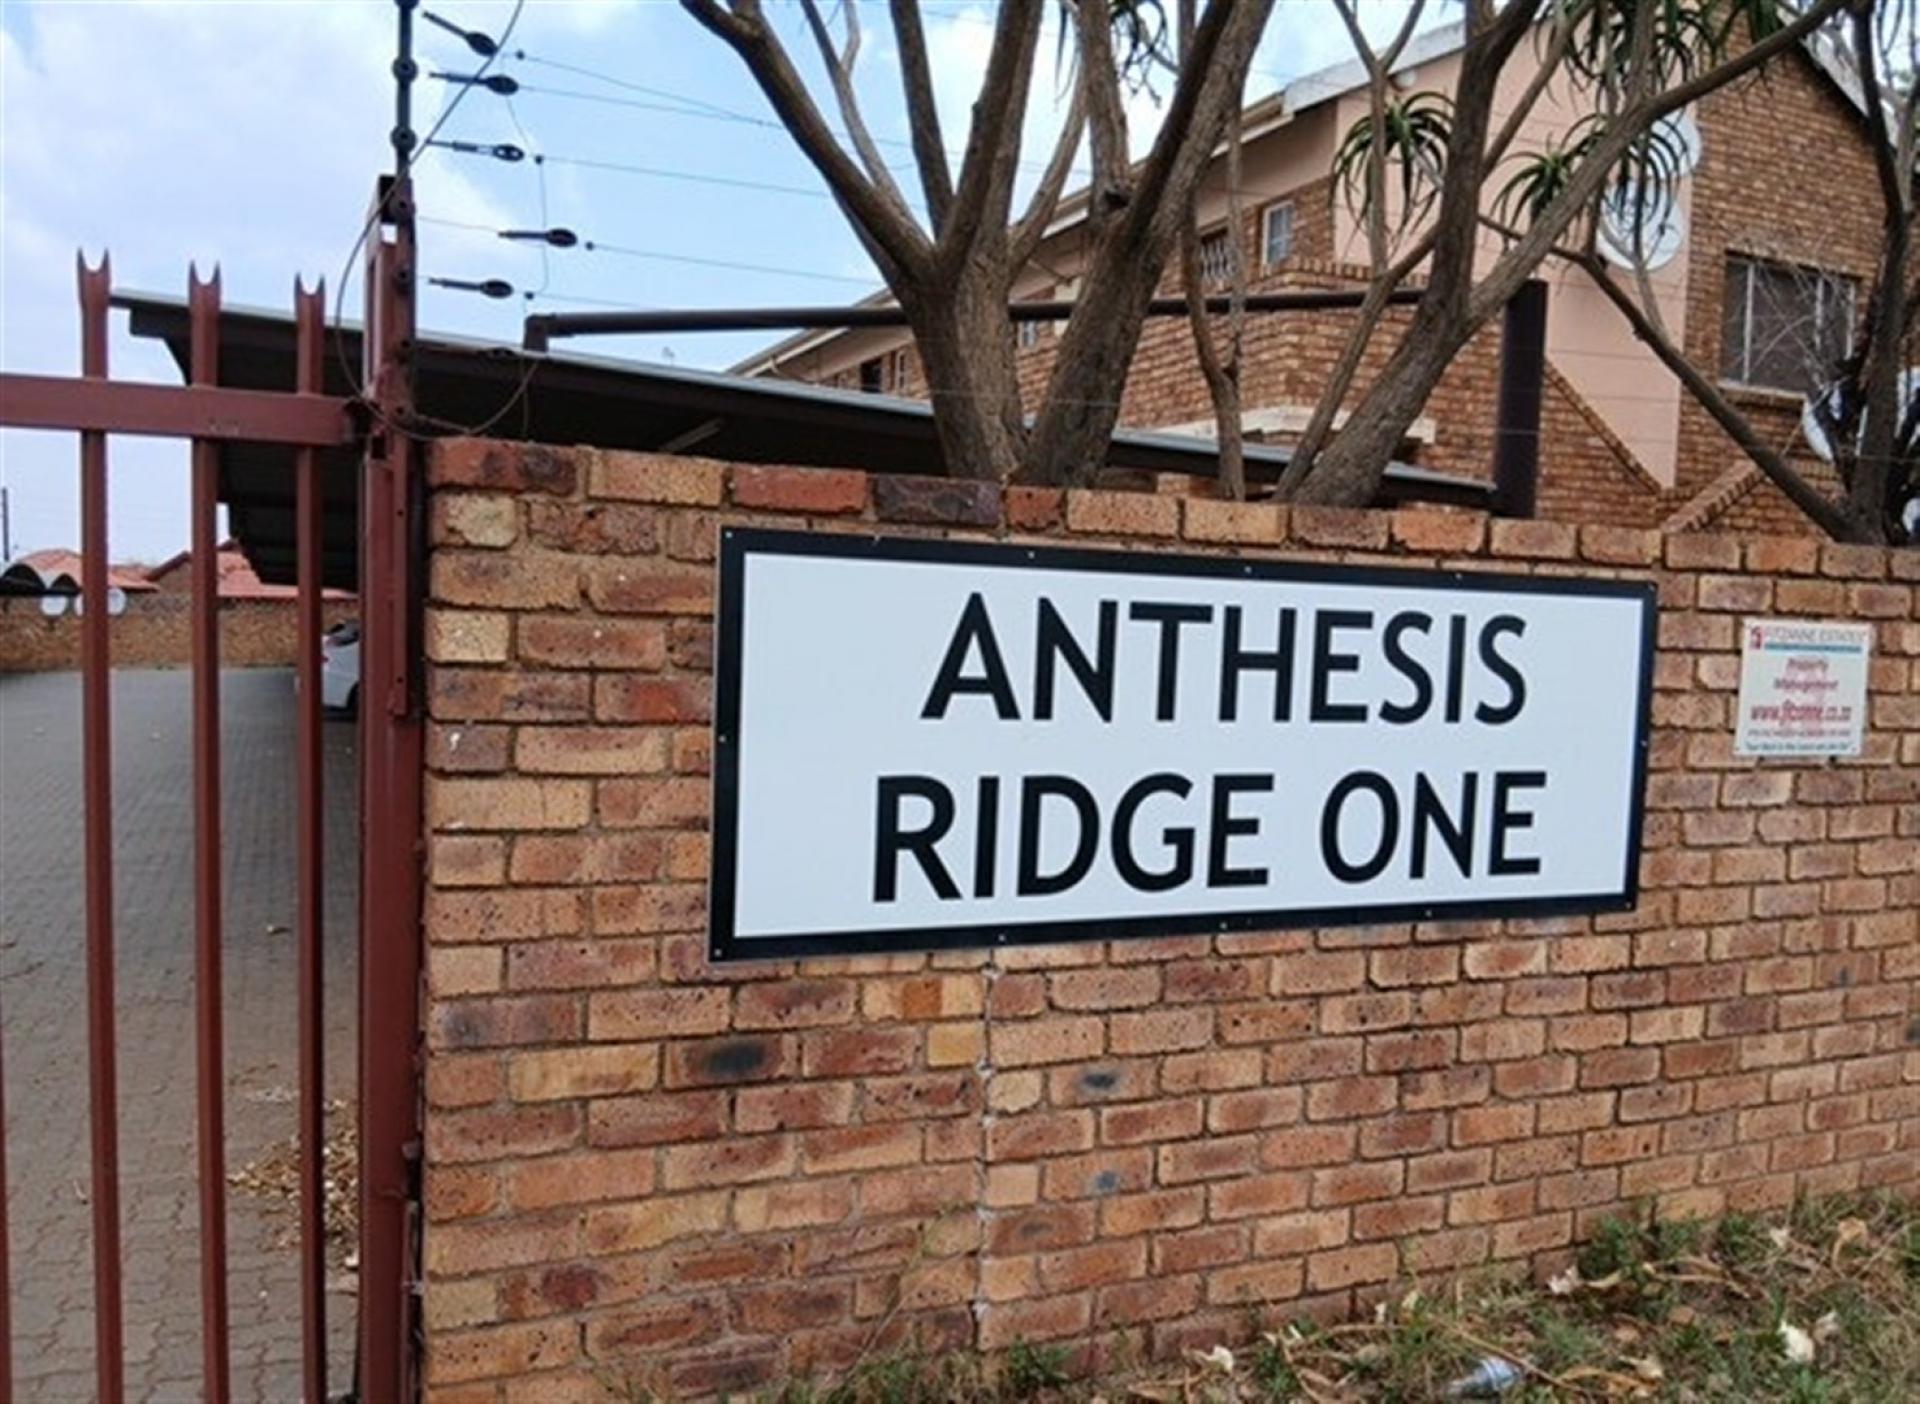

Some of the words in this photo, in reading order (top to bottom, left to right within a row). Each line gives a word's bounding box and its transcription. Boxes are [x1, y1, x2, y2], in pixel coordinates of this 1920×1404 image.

[921, 593, 1527, 725] ANTHESIS
[873, 773, 1274, 903] RIDGE
[1320, 770, 1547, 885] ONE
